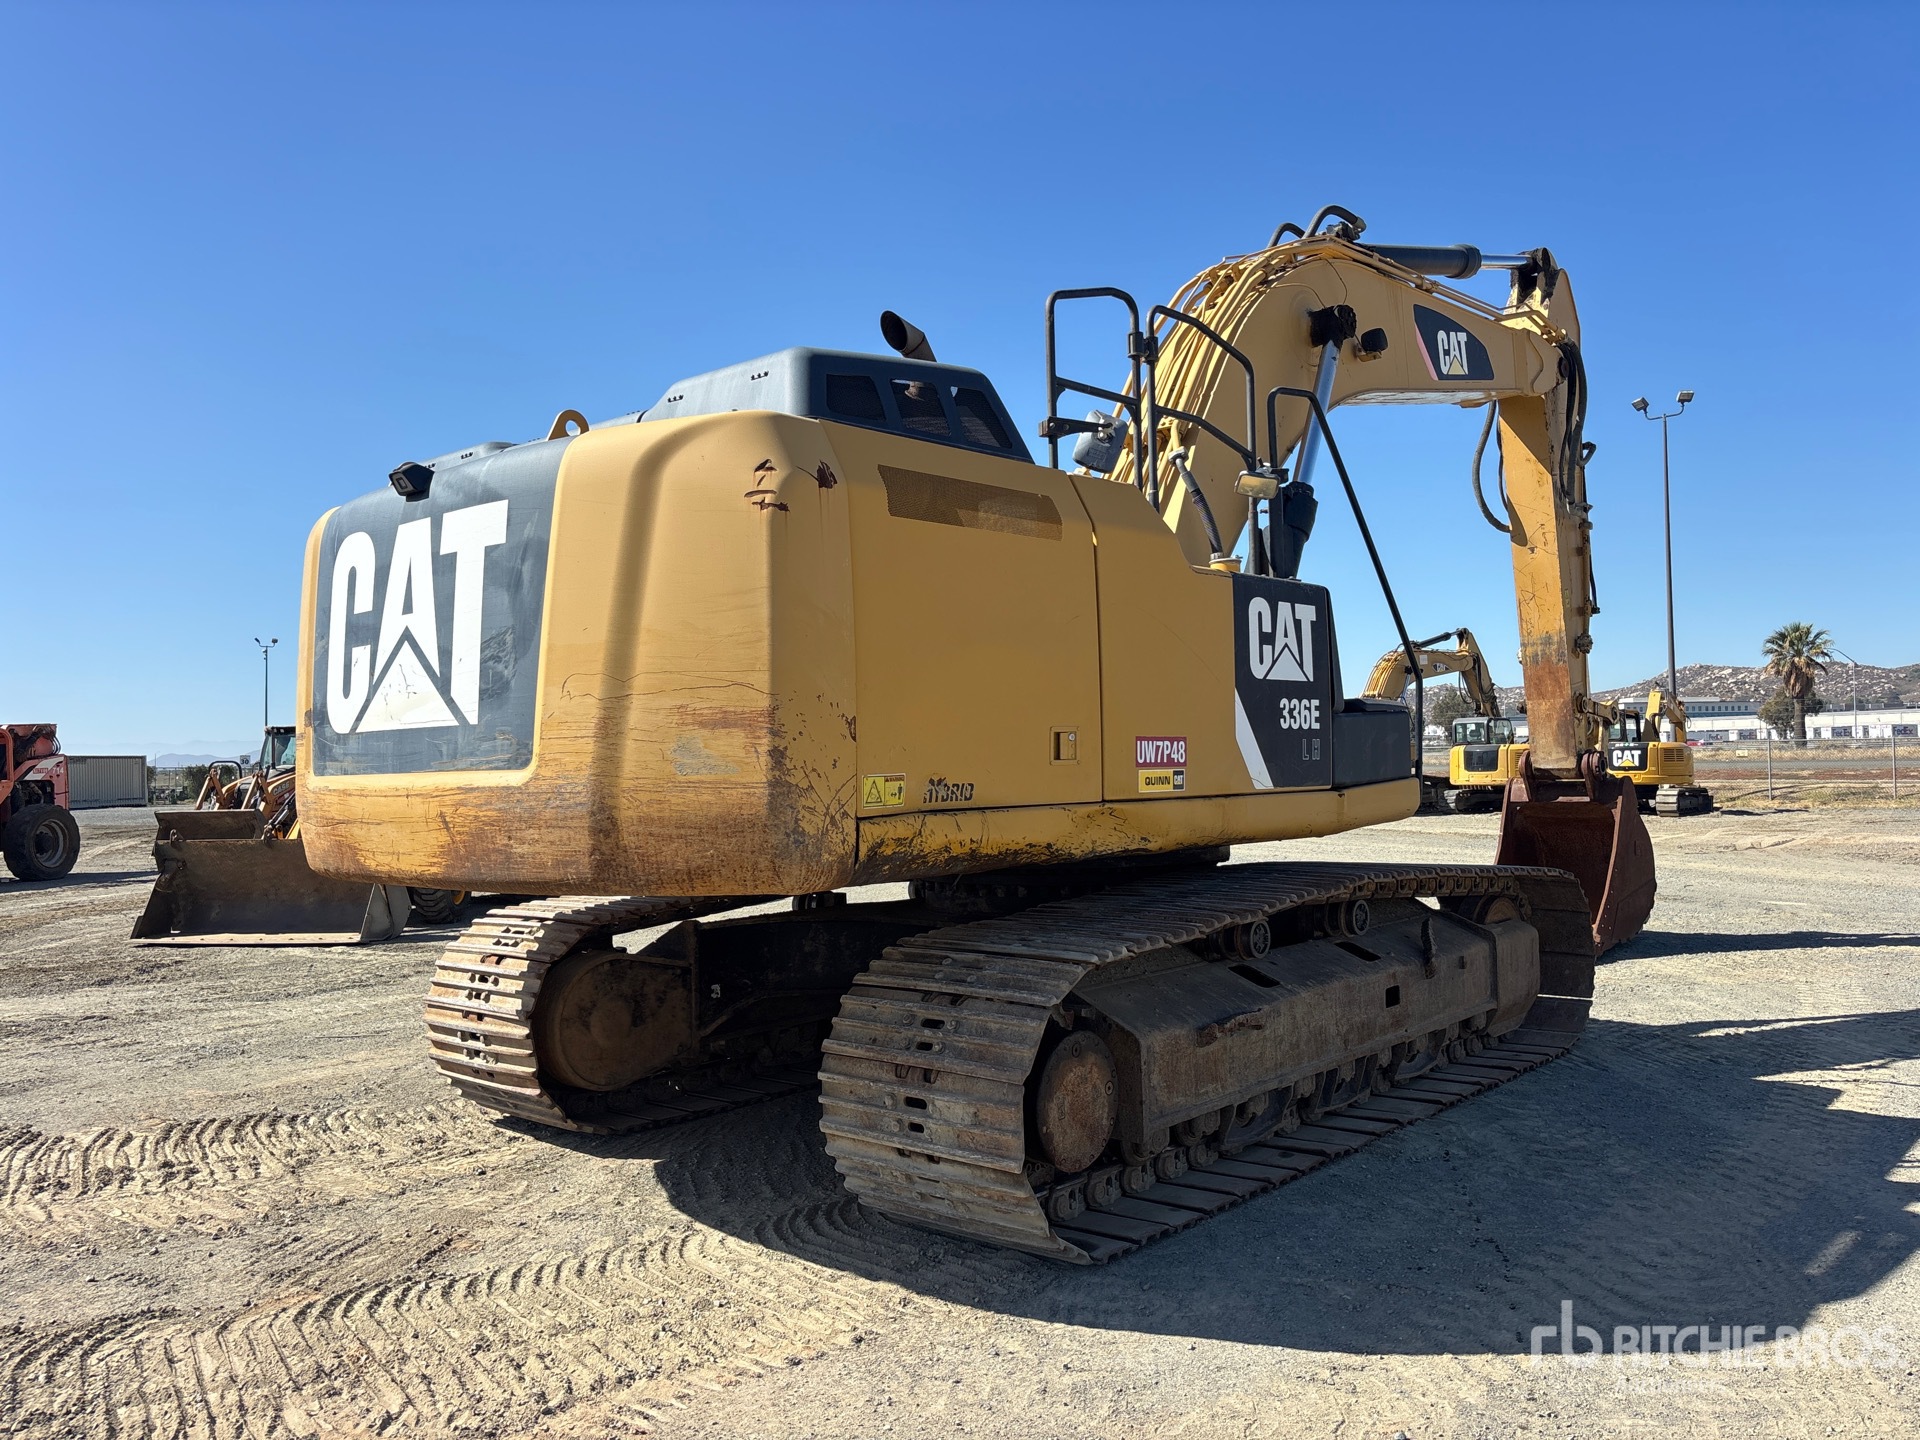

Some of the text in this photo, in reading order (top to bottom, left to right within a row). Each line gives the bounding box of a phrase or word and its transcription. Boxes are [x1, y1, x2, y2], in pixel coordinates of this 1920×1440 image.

[1437, 330, 1469, 375] CAT
[326, 499, 509, 735] CAT
[1248, 597, 1316, 682] CAT
[1279, 698, 1320, 730] 336E
[1892, 726, 1914, 736] FedEx
[240, 757, 250, 765] 30
[1136, 740, 1186, 763] UW7P48
[1612, 750, 1642, 767] CAT
[272, 781, 290, 796] CASE
[1144, 774, 1184, 786] QUINN CAT
